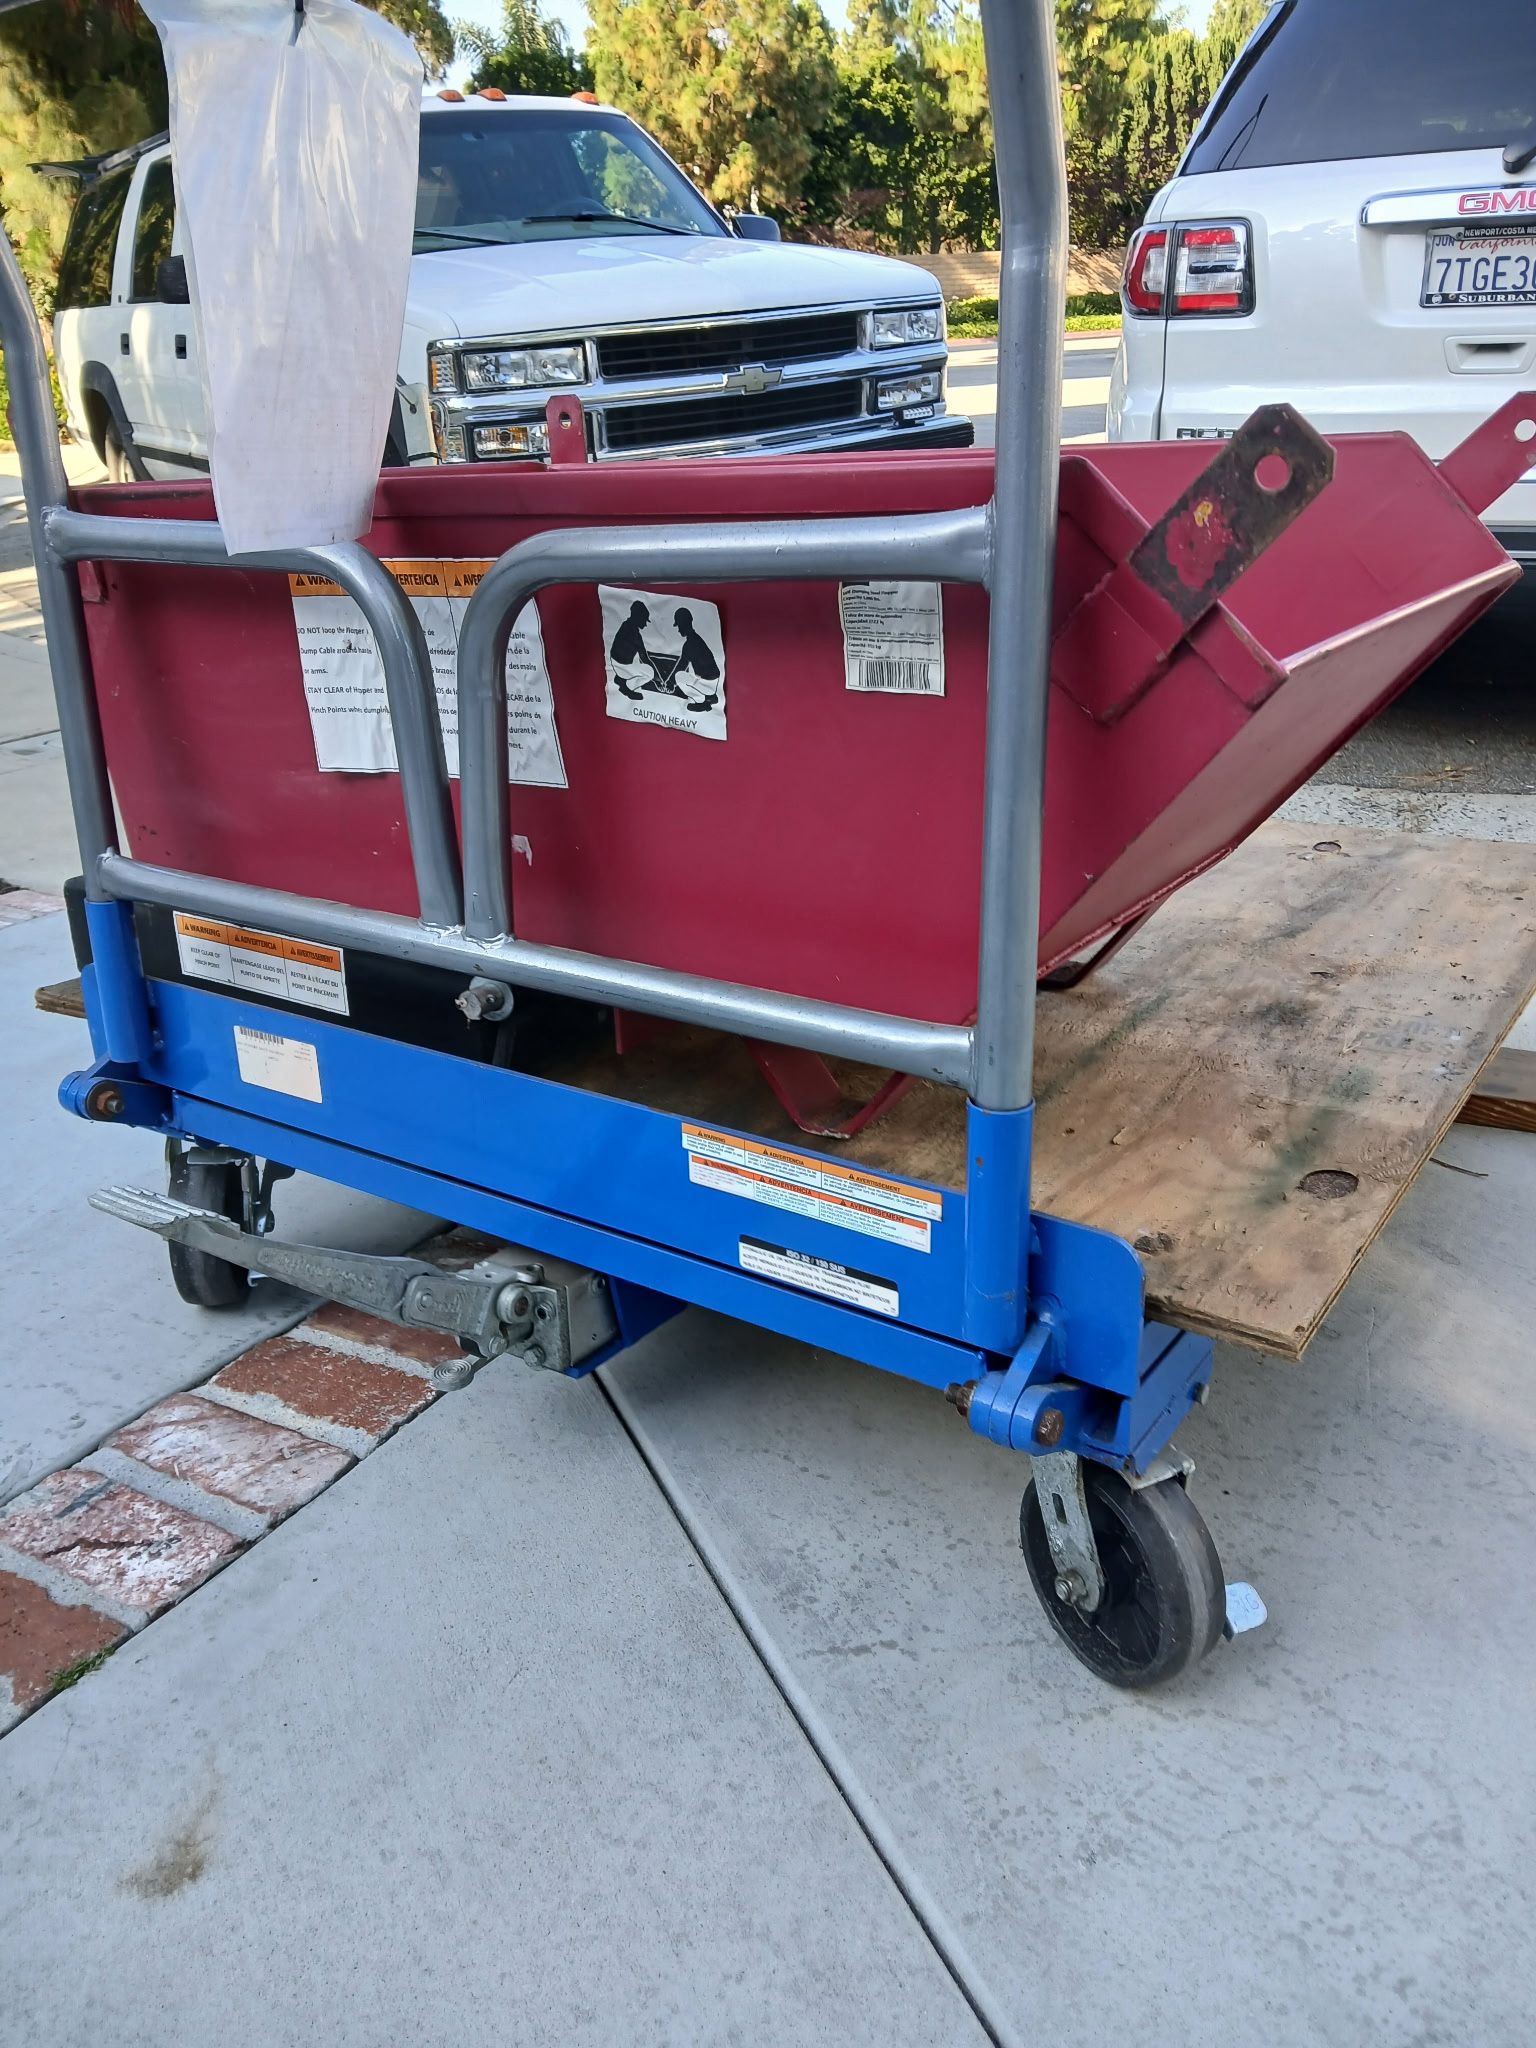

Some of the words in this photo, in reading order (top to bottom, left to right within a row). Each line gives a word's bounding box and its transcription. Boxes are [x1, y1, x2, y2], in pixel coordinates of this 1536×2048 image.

[1457, 189, 1536, 214] GM
[1464, 226, 1525, 236] NEWPORT/COSTA
[1435, 235, 1454, 246] JUN
[1436, 255, 1536, 292] 7TGE3
[306, 626, 321, 634] NOT
[319, 646, 336, 654] Cable
[307, 686, 322, 694] STAY
[323, 686, 345, 694] CLEAR
[327, 705, 346, 714] Points
[632, 707, 667, 725] CAUTION
[668, 715, 698, 729] HEAVY
[190, 924, 221, 938] WARNING
[241, 936, 277, 951] ADVERTENCIA
[297, 949, 334, 963] AVERTISSEMENT
[703, 1133, 727, 1144] WARNING
[769, 1151, 805, 1167] ADVERTENCIA
[769, 1177, 812, 1196] ADVERTENCIA
[855, 1176, 901, 1193] AVERTISSEMENT
[850, 1201, 905, 1223] AVERTISSEMENT
[786, 1248, 801, 1261] ISO
